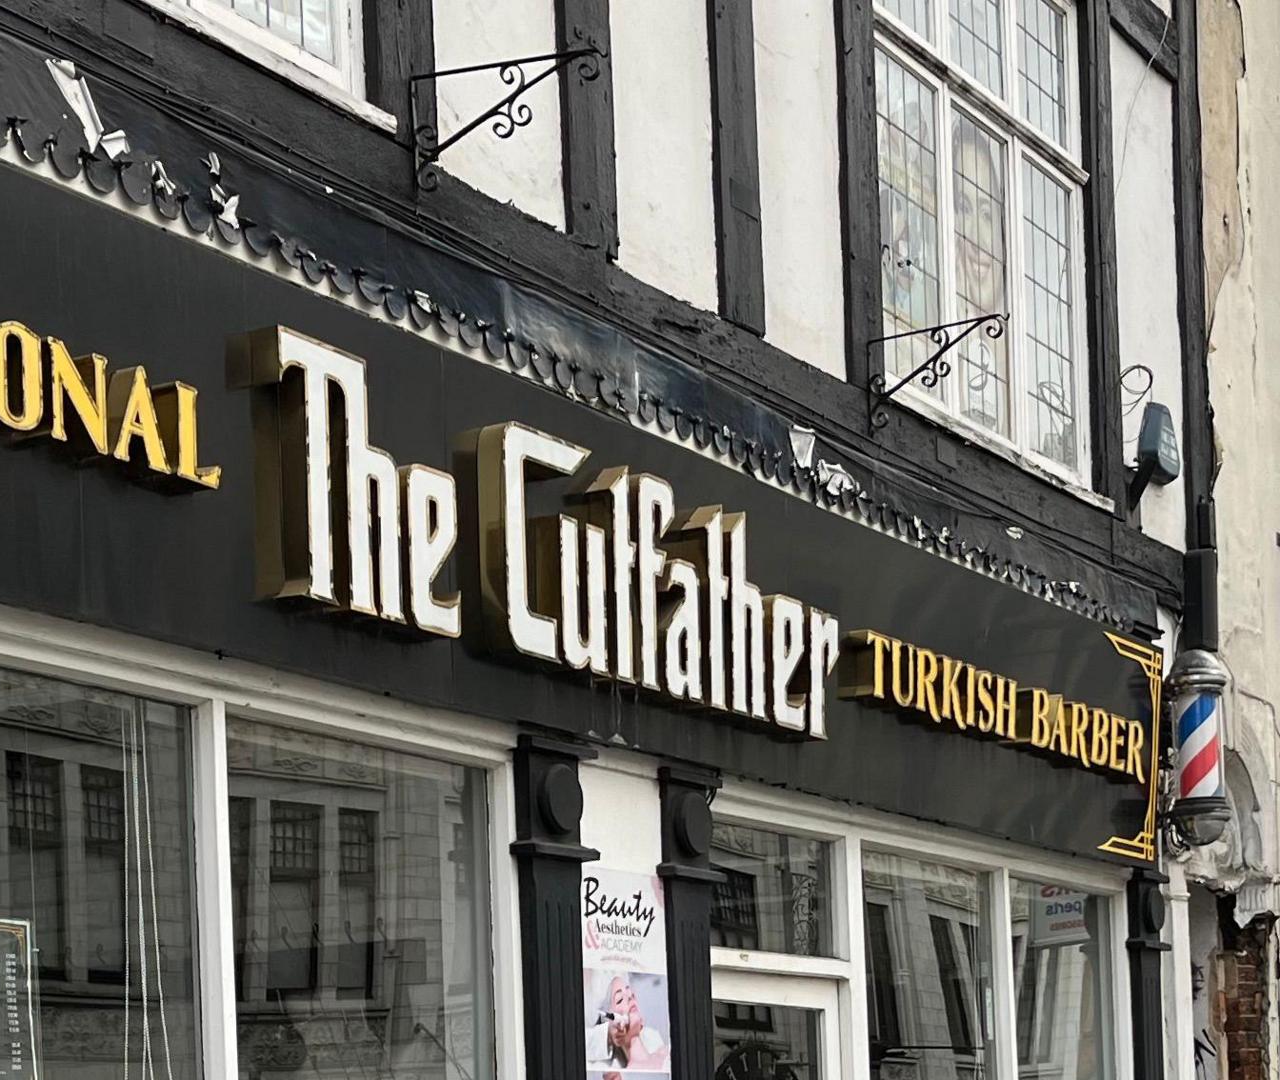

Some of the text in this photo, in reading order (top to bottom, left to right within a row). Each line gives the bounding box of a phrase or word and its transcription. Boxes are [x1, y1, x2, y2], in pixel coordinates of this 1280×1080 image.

[276, 325, 840, 740] The Cutfather
[867, 632, 1146, 785] TURKISH BARBER
[584, 877, 655, 937] Beauty
[596, 919, 642, 938] Aesthetics
[601, 938, 643, 953] ACADEMY
